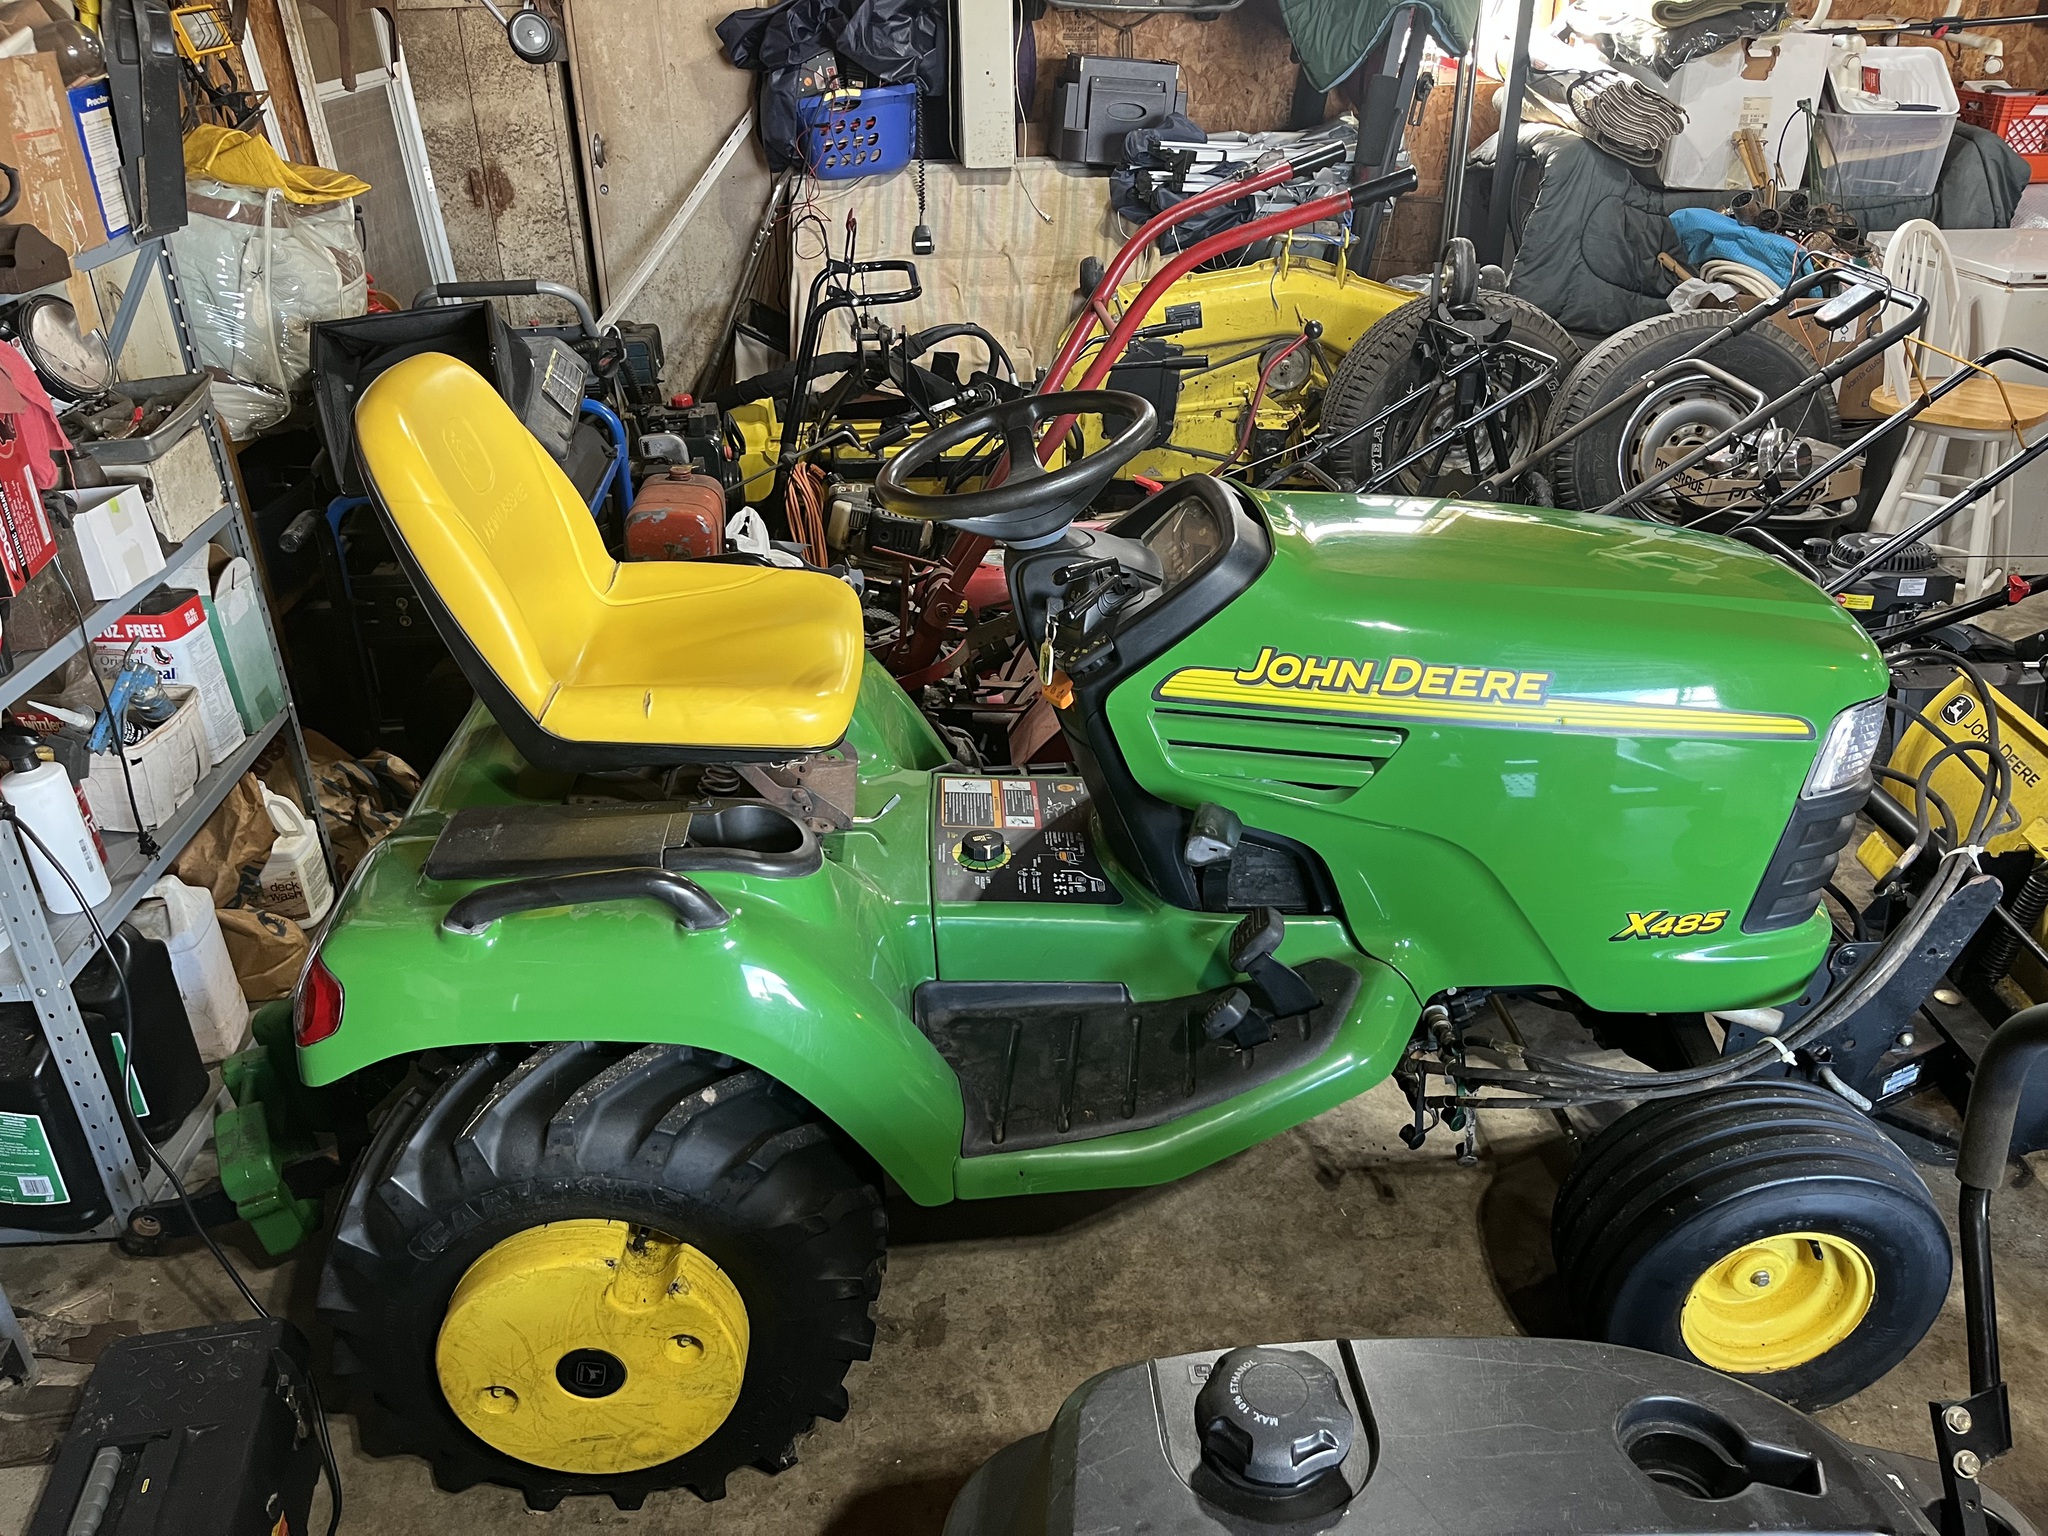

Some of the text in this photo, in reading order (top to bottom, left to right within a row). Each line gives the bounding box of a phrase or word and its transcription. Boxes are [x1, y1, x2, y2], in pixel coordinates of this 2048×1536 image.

[125, 623, 166, 638] FREE!
[1236, 647, 1552, 703] JOHN DEERE
[1999, 743, 2041, 788] DEERE
[270, 881, 300, 892] deck
[270, 890, 303, 901] wash
[1609, 910, 1730, 941] X485
[1229, 1360, 1279, 1427] MAX. 10% ETHANOL
